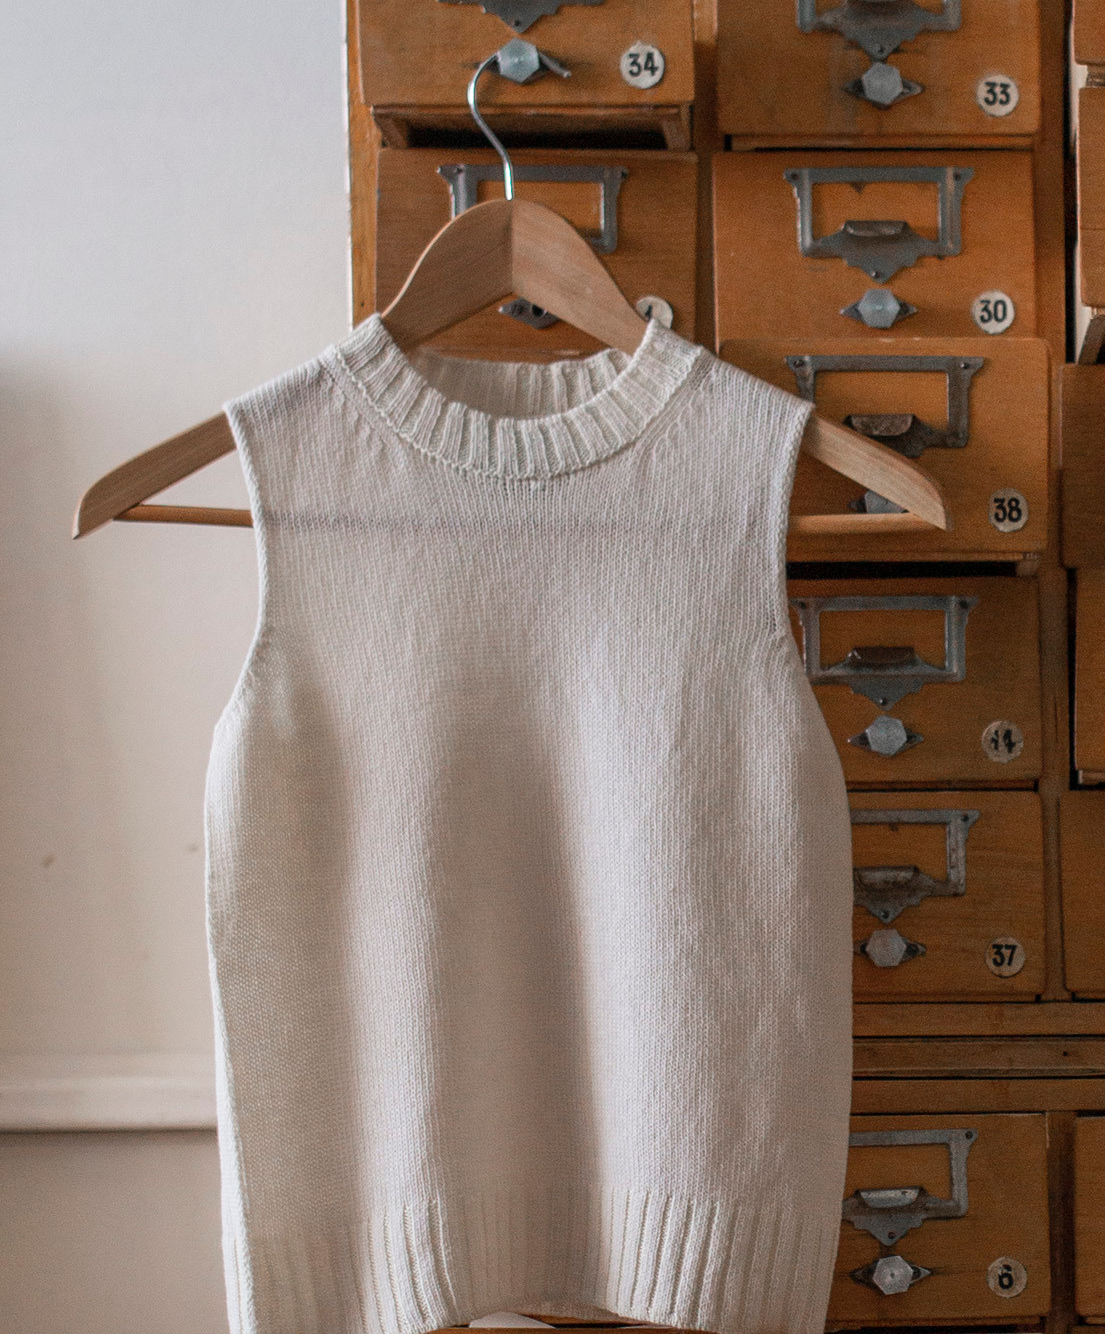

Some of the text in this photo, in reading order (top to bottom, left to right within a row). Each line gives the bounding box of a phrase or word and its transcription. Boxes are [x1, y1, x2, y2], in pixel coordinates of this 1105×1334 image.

[629, 53, 658, 77] 34
[984, 81, 1011, 105] 33
[979, 299, 1006, 323] 30
[993, 498, 1022, 523] 38
[992, 944, 1018, 967] 37
[997, 1264, 1014, 1289] 6
